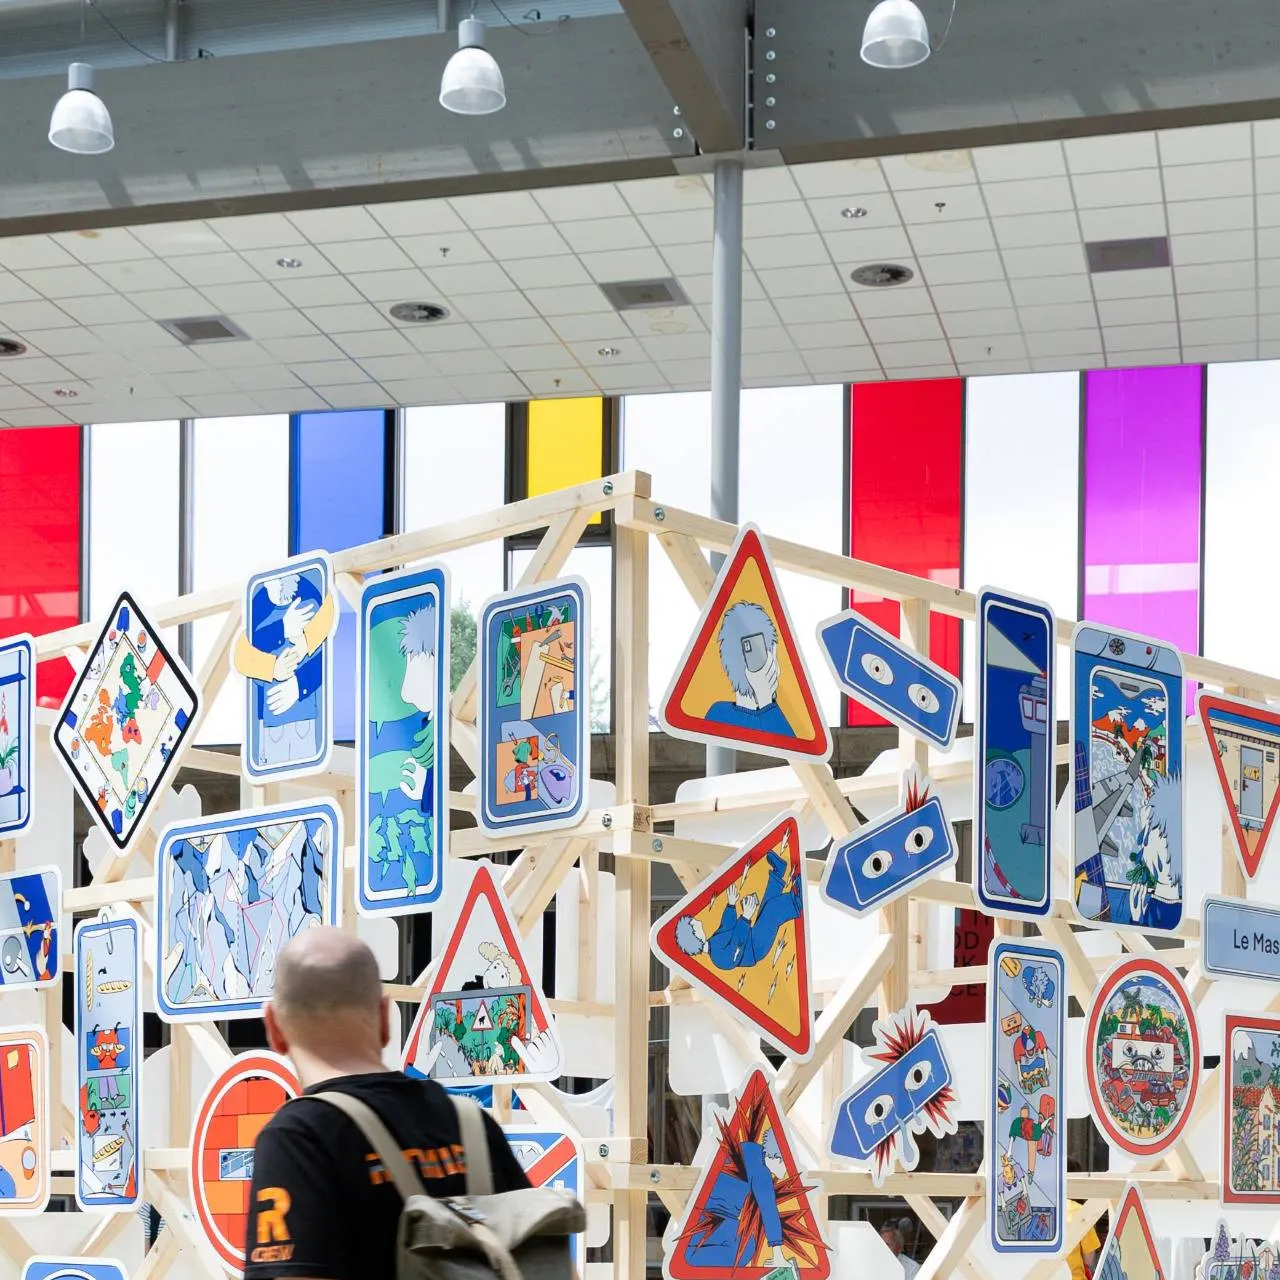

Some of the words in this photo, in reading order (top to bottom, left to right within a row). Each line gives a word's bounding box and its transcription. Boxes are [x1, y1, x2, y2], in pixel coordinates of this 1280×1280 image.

[1233, 928, 1249, 950] Le
[1253, 932, 1280, 955] Mas
[256, 1186, 291, 1244] R
